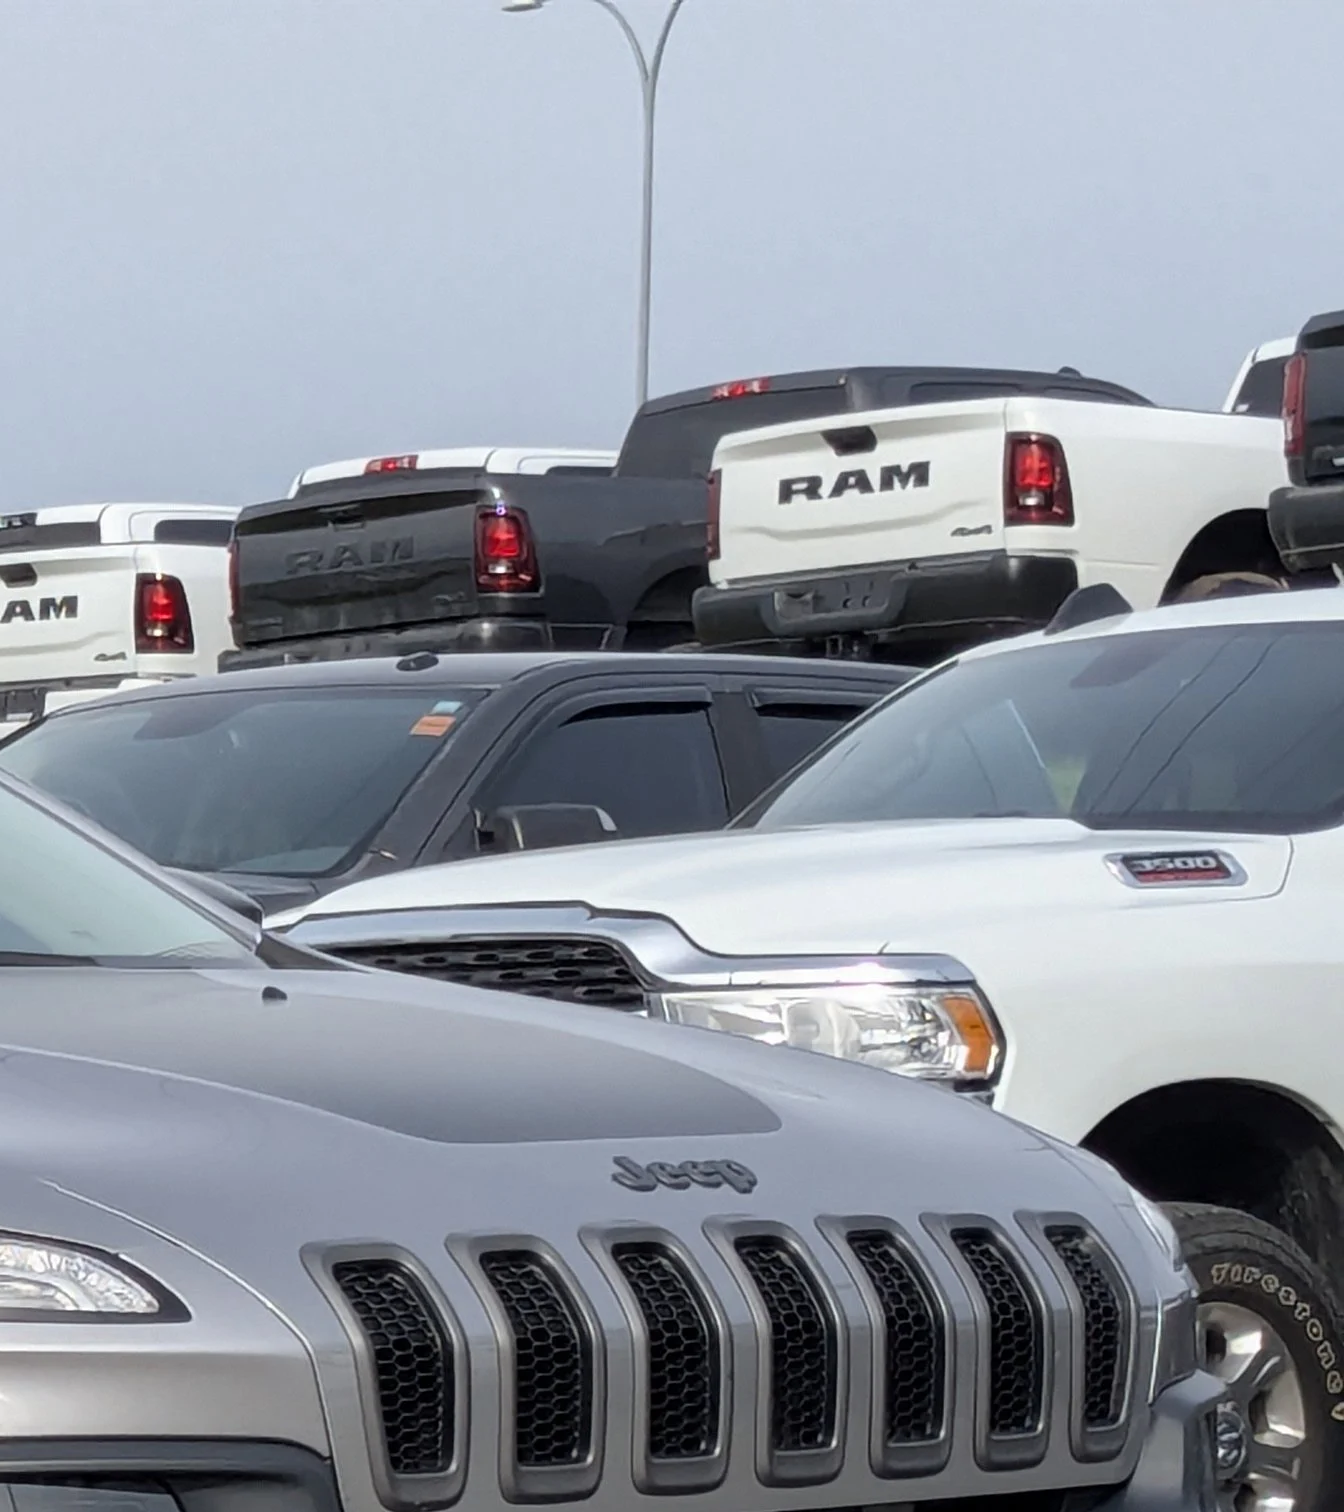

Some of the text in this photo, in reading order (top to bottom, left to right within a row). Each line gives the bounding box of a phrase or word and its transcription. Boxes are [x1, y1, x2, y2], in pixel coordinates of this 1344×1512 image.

[778, 461, 930, 505] RAM
[286, 535, 415, 575] RAM
[1132, 855, 1217, 872] 3500
[611, 1156, 758, 1194] Jeep
[1211, 1262, 1344, 1394] Firestone
